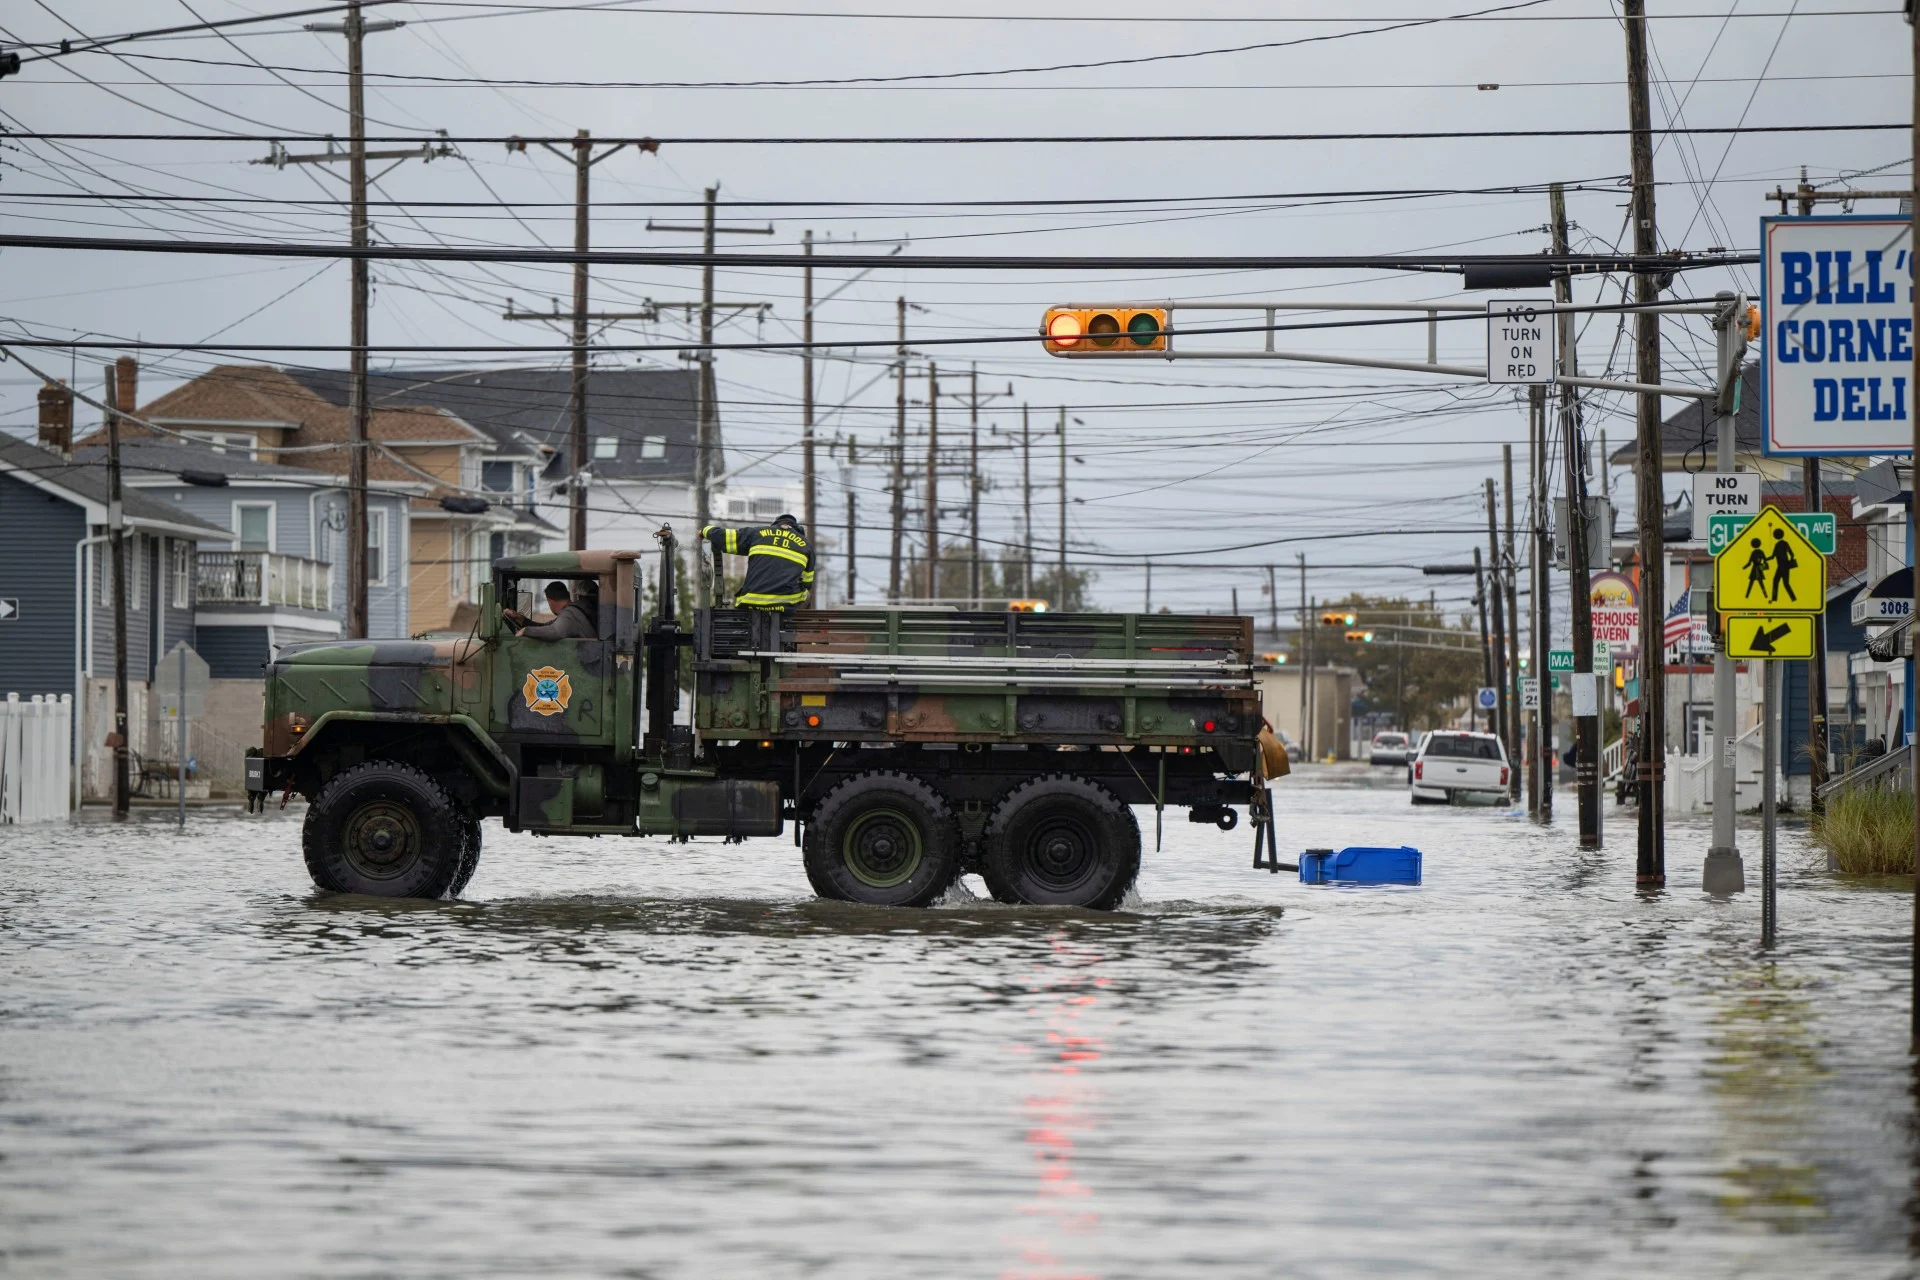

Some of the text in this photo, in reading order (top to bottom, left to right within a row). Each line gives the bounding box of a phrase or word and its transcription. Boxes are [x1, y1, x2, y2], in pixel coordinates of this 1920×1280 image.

[1507, 307, 1536, 322] NO
[1502, 328, 1541, 340] TURN
[1511, 346, 1532, 358] ON
[1508, 364, 1536, 376] RED
[1813, 377, 1906, 421] DELI
[1715, 477, 1737, 488] NO
[1706, 494, 1748, 505] TURN
[1812, 522, 1832, 533] AVE
[760, 529, 806, 547] WILDWOOD
[1880, 601, 1909, 614] 3008
[1591, 627, 1630, 641] TAVERN
[1596, 642, 1606, 654] 15
